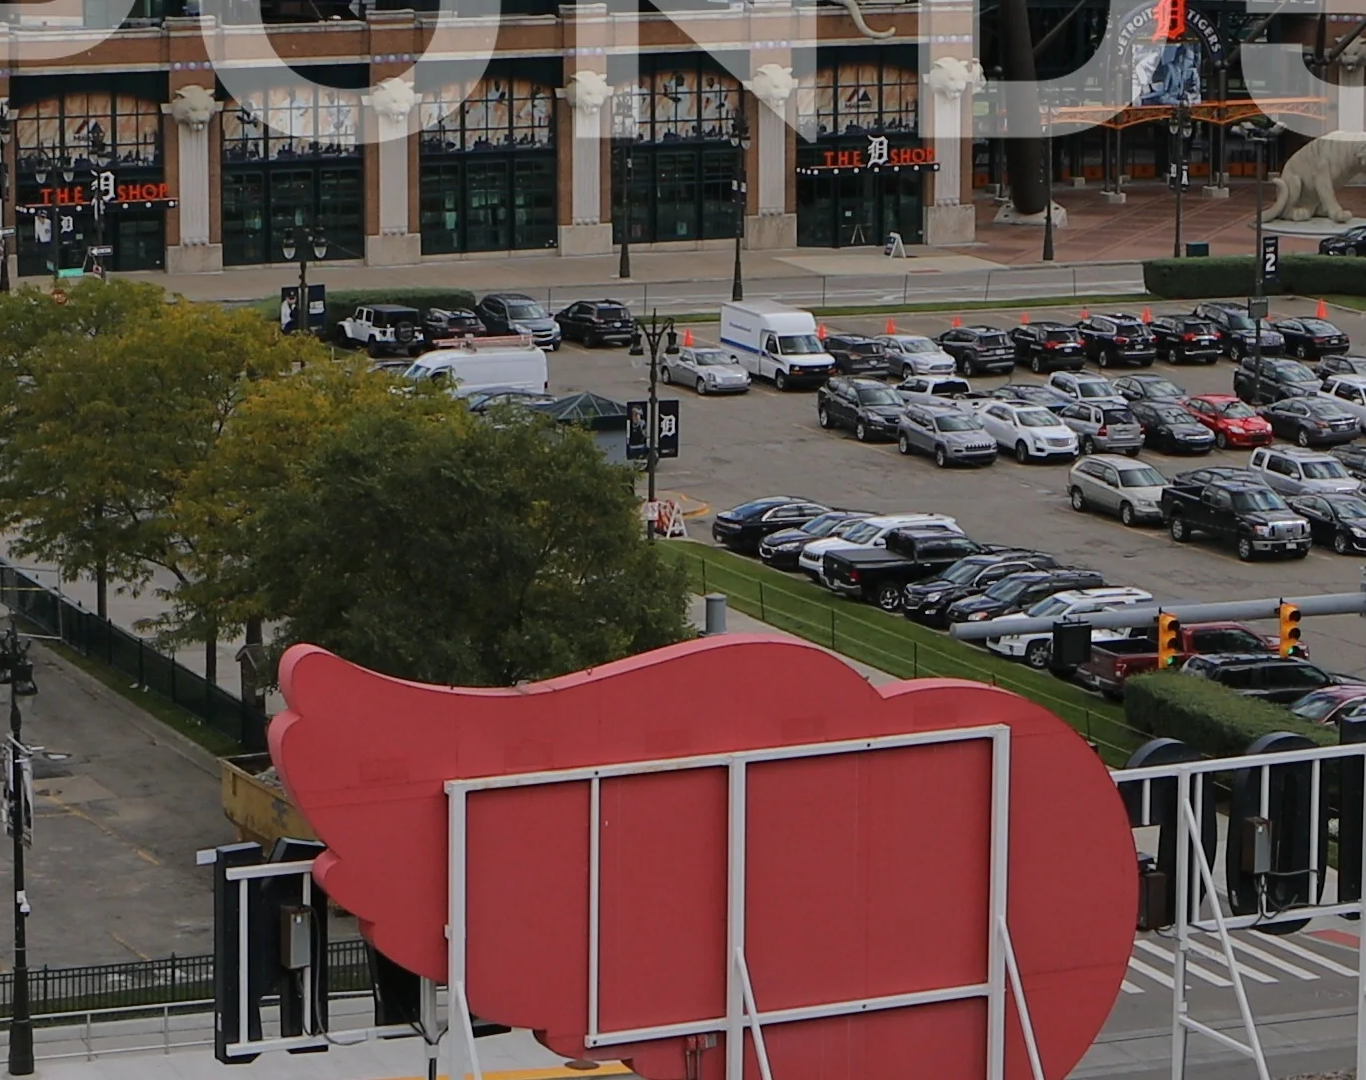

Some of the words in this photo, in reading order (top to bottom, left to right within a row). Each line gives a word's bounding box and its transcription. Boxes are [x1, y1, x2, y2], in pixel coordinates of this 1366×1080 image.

[1187, 9, 1221, 53] TIGERS
[824, 149, 861, 166] THE
[890, 148, 937, 164] SHOP
[41, 187, 83, 205] THE
[117, 183, 169, 201] SHOP
[1265, 254, 1275, 272] 2
